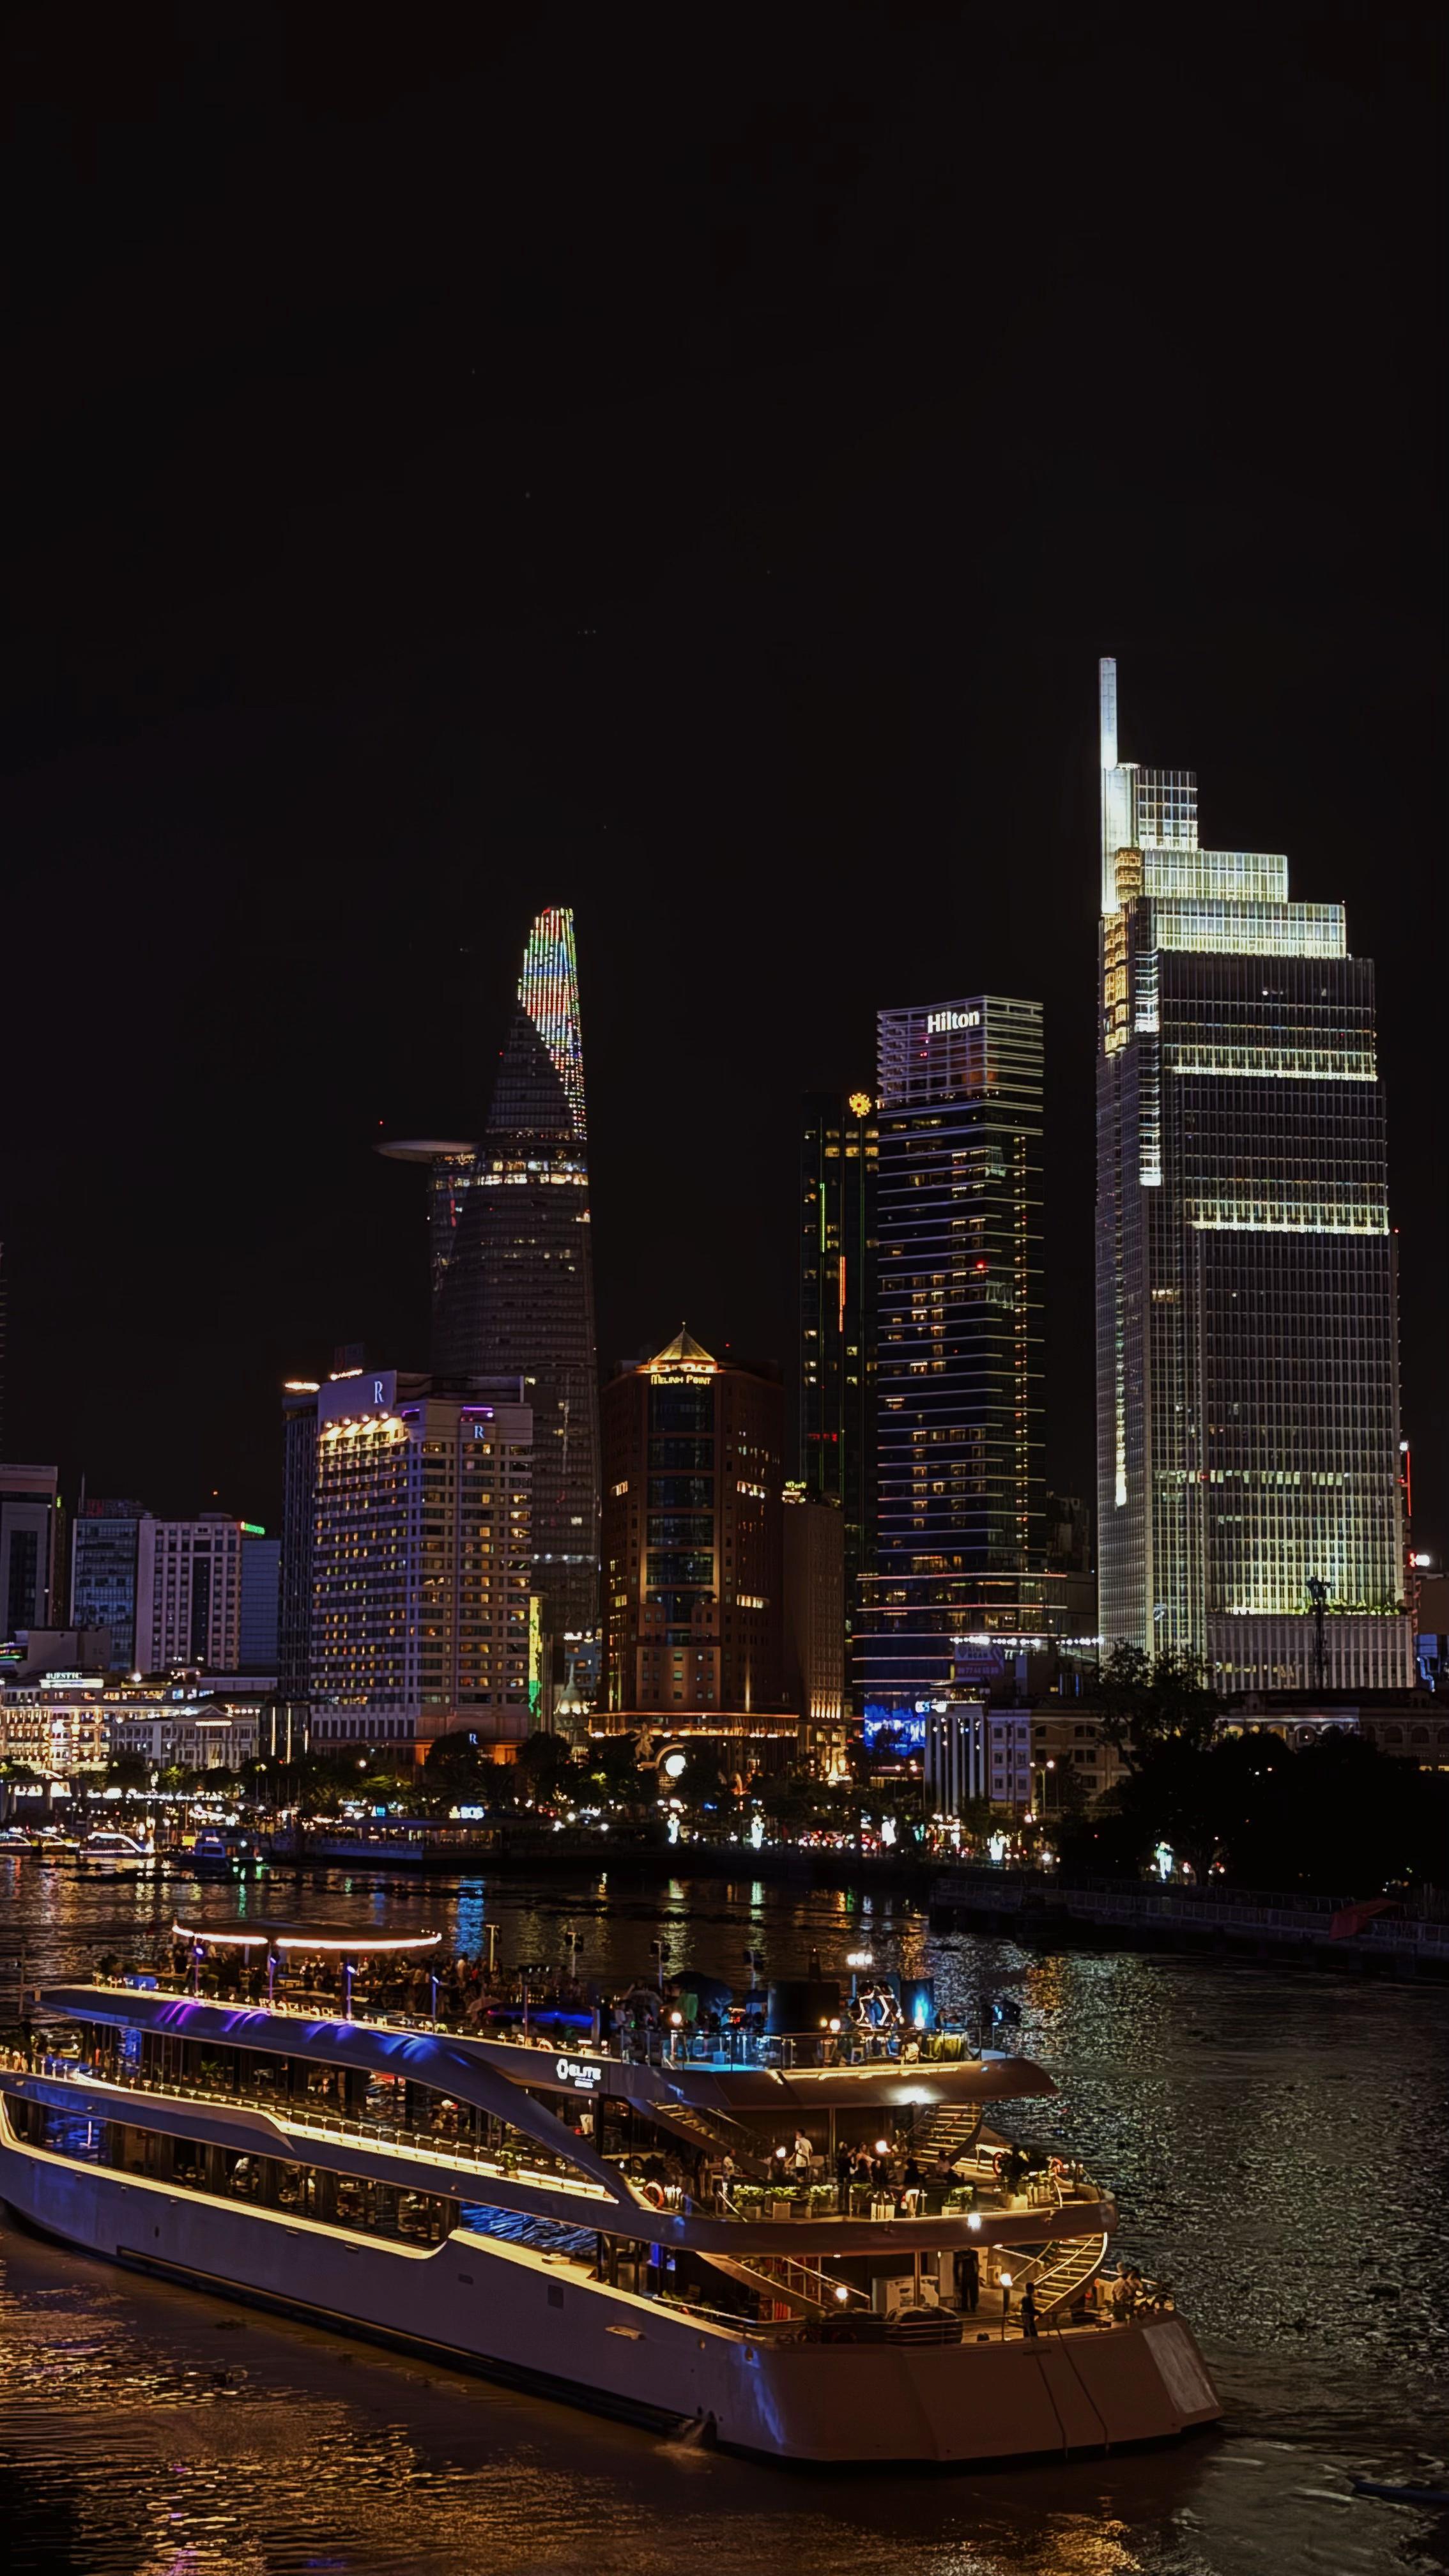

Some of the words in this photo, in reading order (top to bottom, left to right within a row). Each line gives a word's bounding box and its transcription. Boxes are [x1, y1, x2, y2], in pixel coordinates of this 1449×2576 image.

[928, 1011, 980, 1033] Hilton
[374, 1381, 385, 1404] R
[474, 1425, 485, 1439] R
[469, 1733, 479, 1744] R
